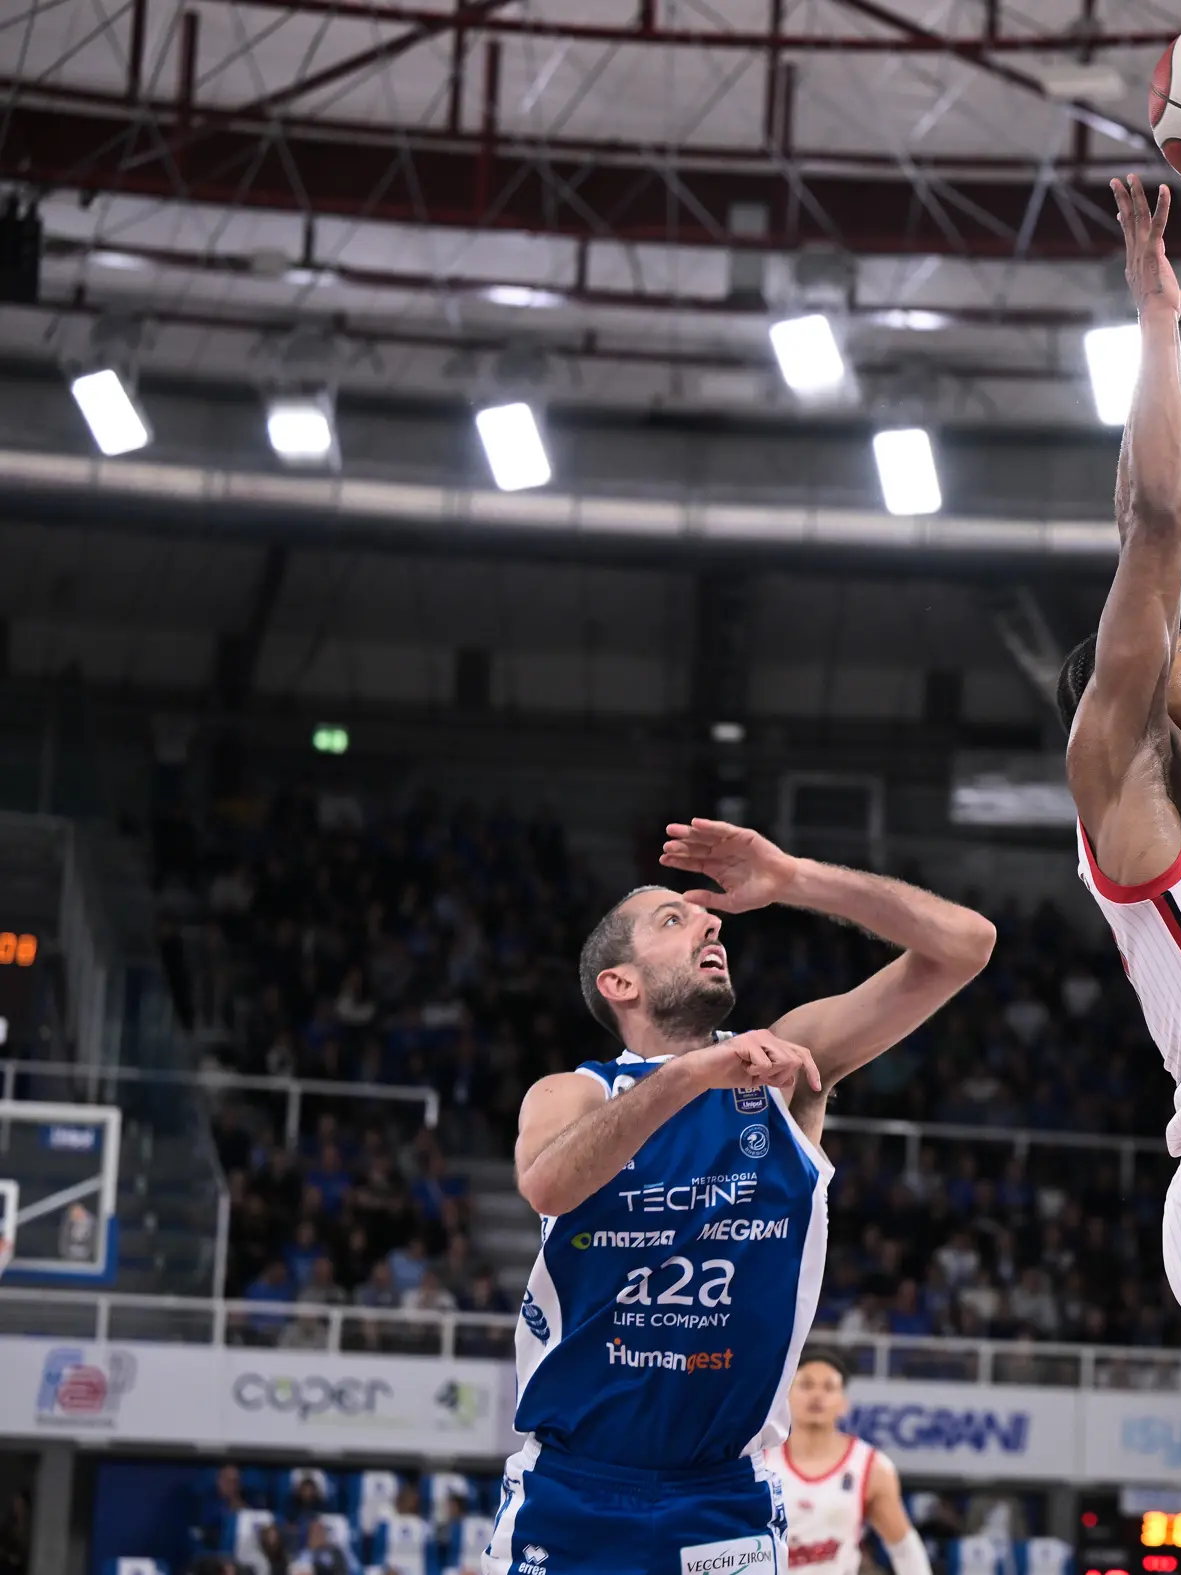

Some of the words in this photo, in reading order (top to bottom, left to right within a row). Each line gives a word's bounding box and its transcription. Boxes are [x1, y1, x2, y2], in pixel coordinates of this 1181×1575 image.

[691, 1171, 758, 1186] METROLOGIA
[618, 1180, 758, 1212] TECHNE
[593, 1230, 676, 1248] mazza
[616, 1256, 736, 1308] a2a
[613, 1311, 646, 1328] LIFE
[651, 1312, 731, 1329] COMPANY
[606, 1337, 735, 1375] Humangest
[686, 1555, 735, 1573] VECCHI
